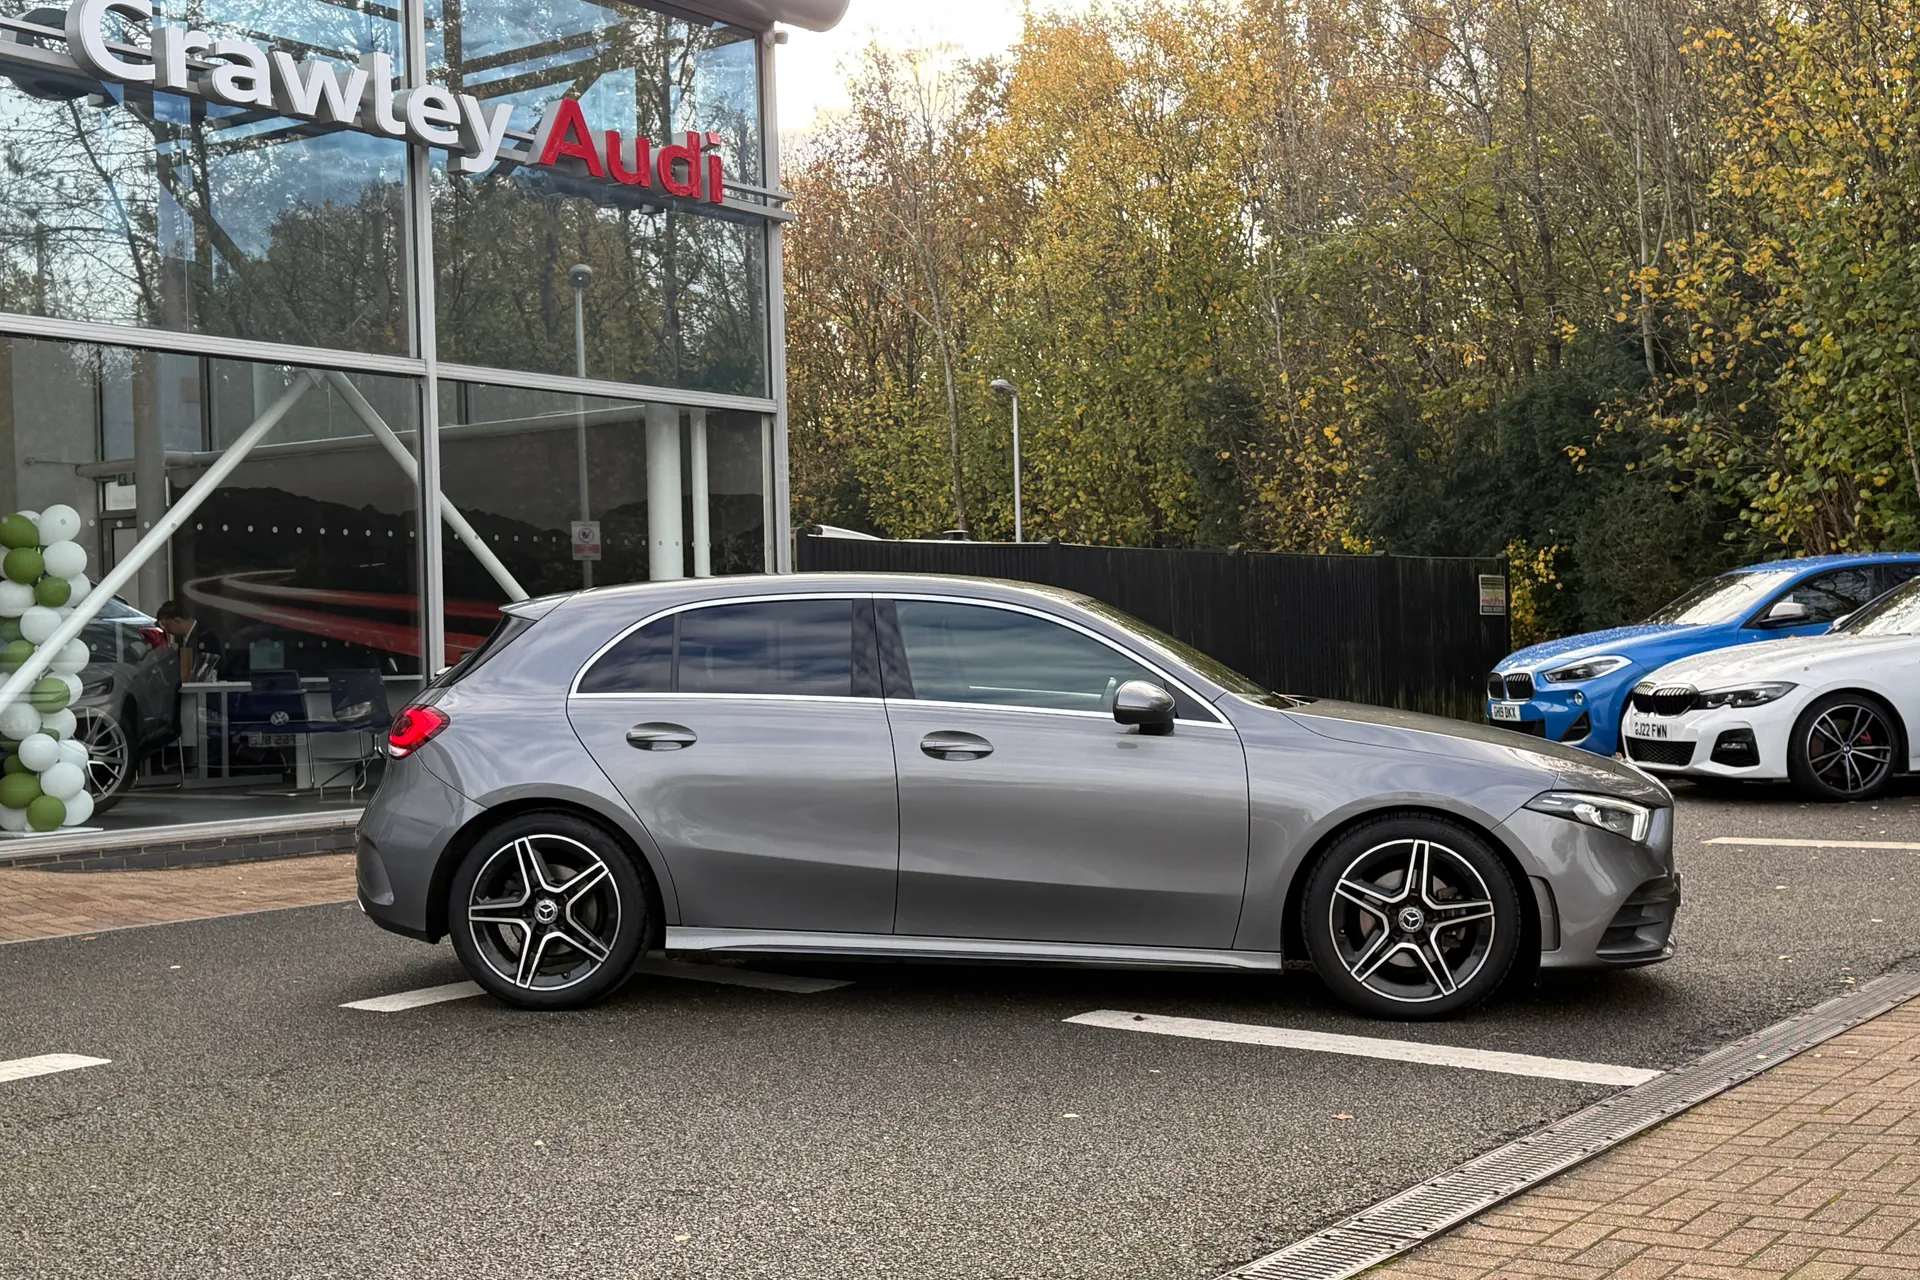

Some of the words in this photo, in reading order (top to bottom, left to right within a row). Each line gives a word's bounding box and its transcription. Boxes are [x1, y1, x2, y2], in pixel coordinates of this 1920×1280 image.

[68, 0, 513, 173] Crawley
[536, 98, 723, 204] Audi
[1651, 723, 1668, 738] FWN
